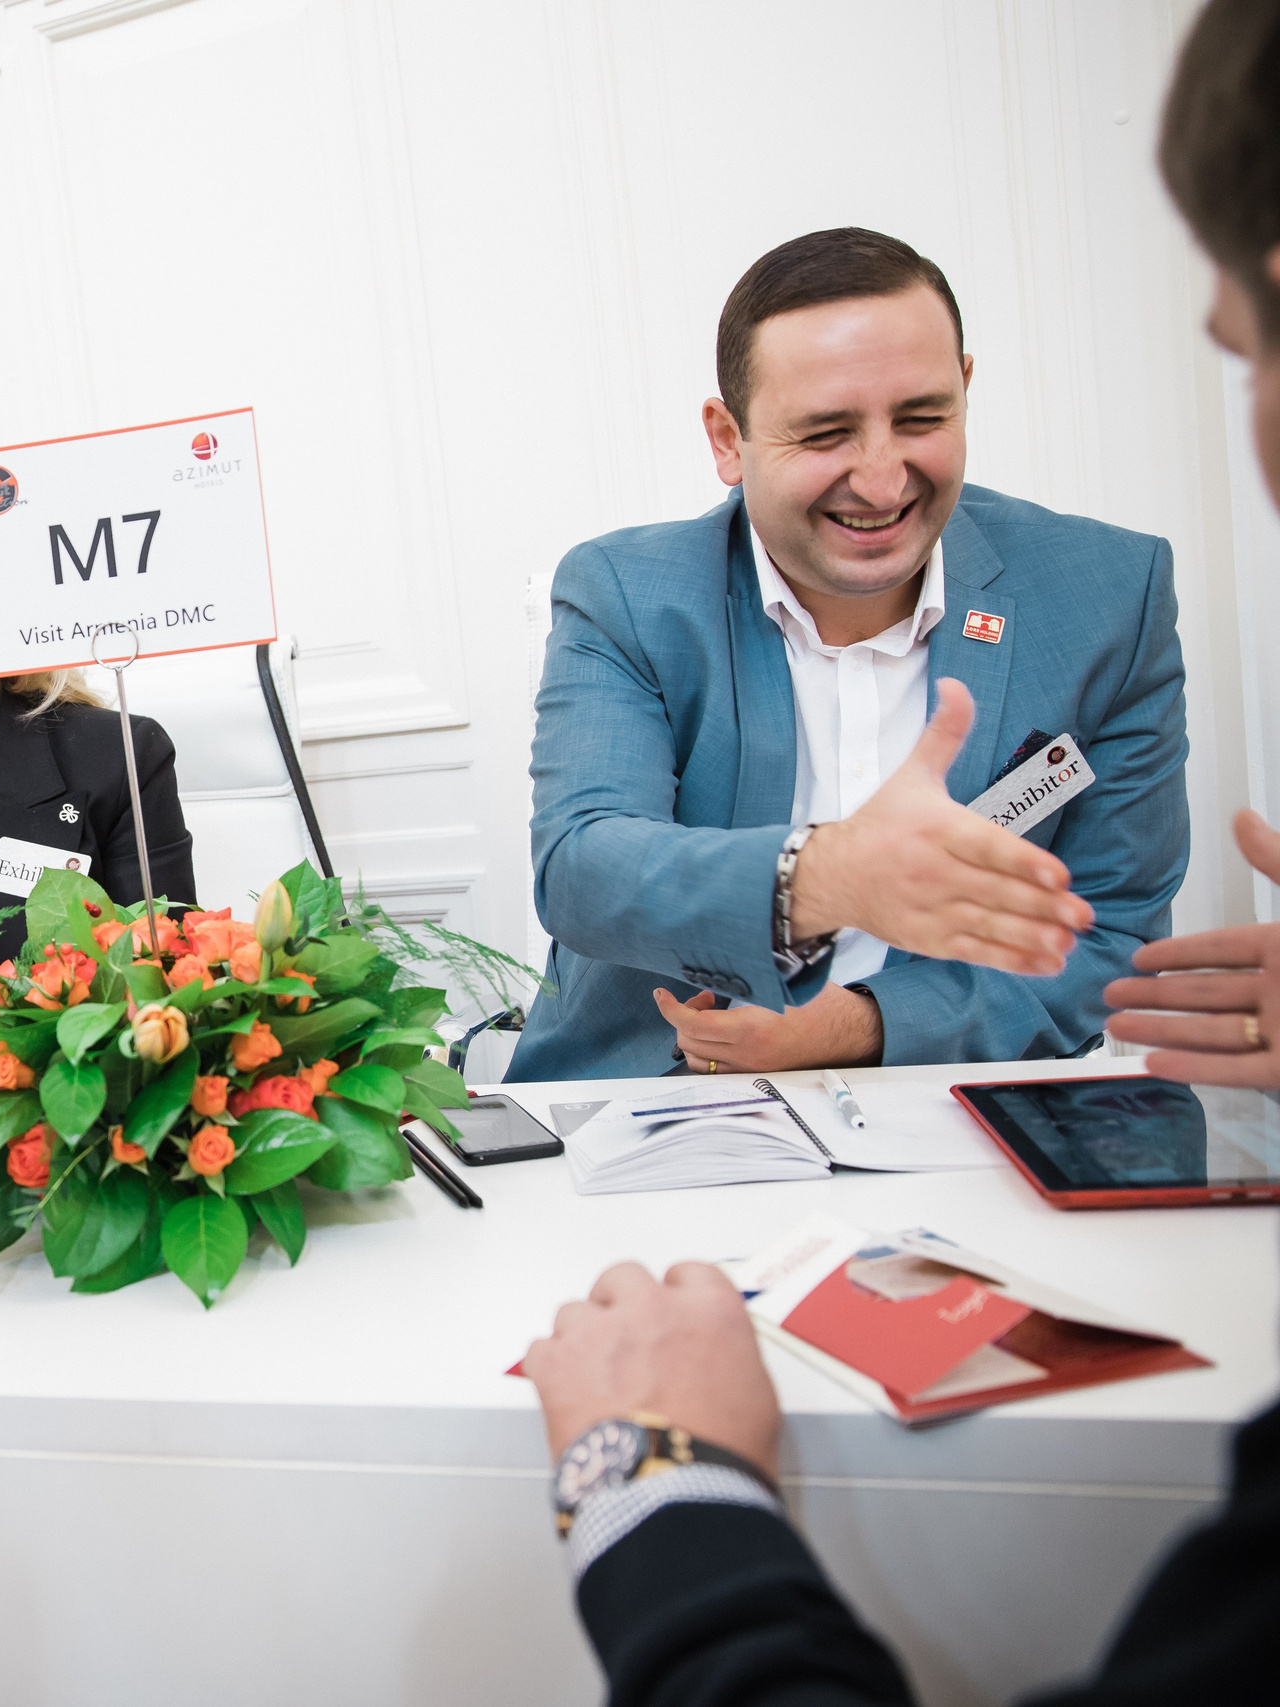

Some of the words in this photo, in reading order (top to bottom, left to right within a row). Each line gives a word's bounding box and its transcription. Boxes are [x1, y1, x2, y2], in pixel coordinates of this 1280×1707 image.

[49, 510, 161, 585] M7
[19, 626, 64, 645] Visit
[71, 613, 158, 639] Armenia
[165, 604, 216, 627] DMC
